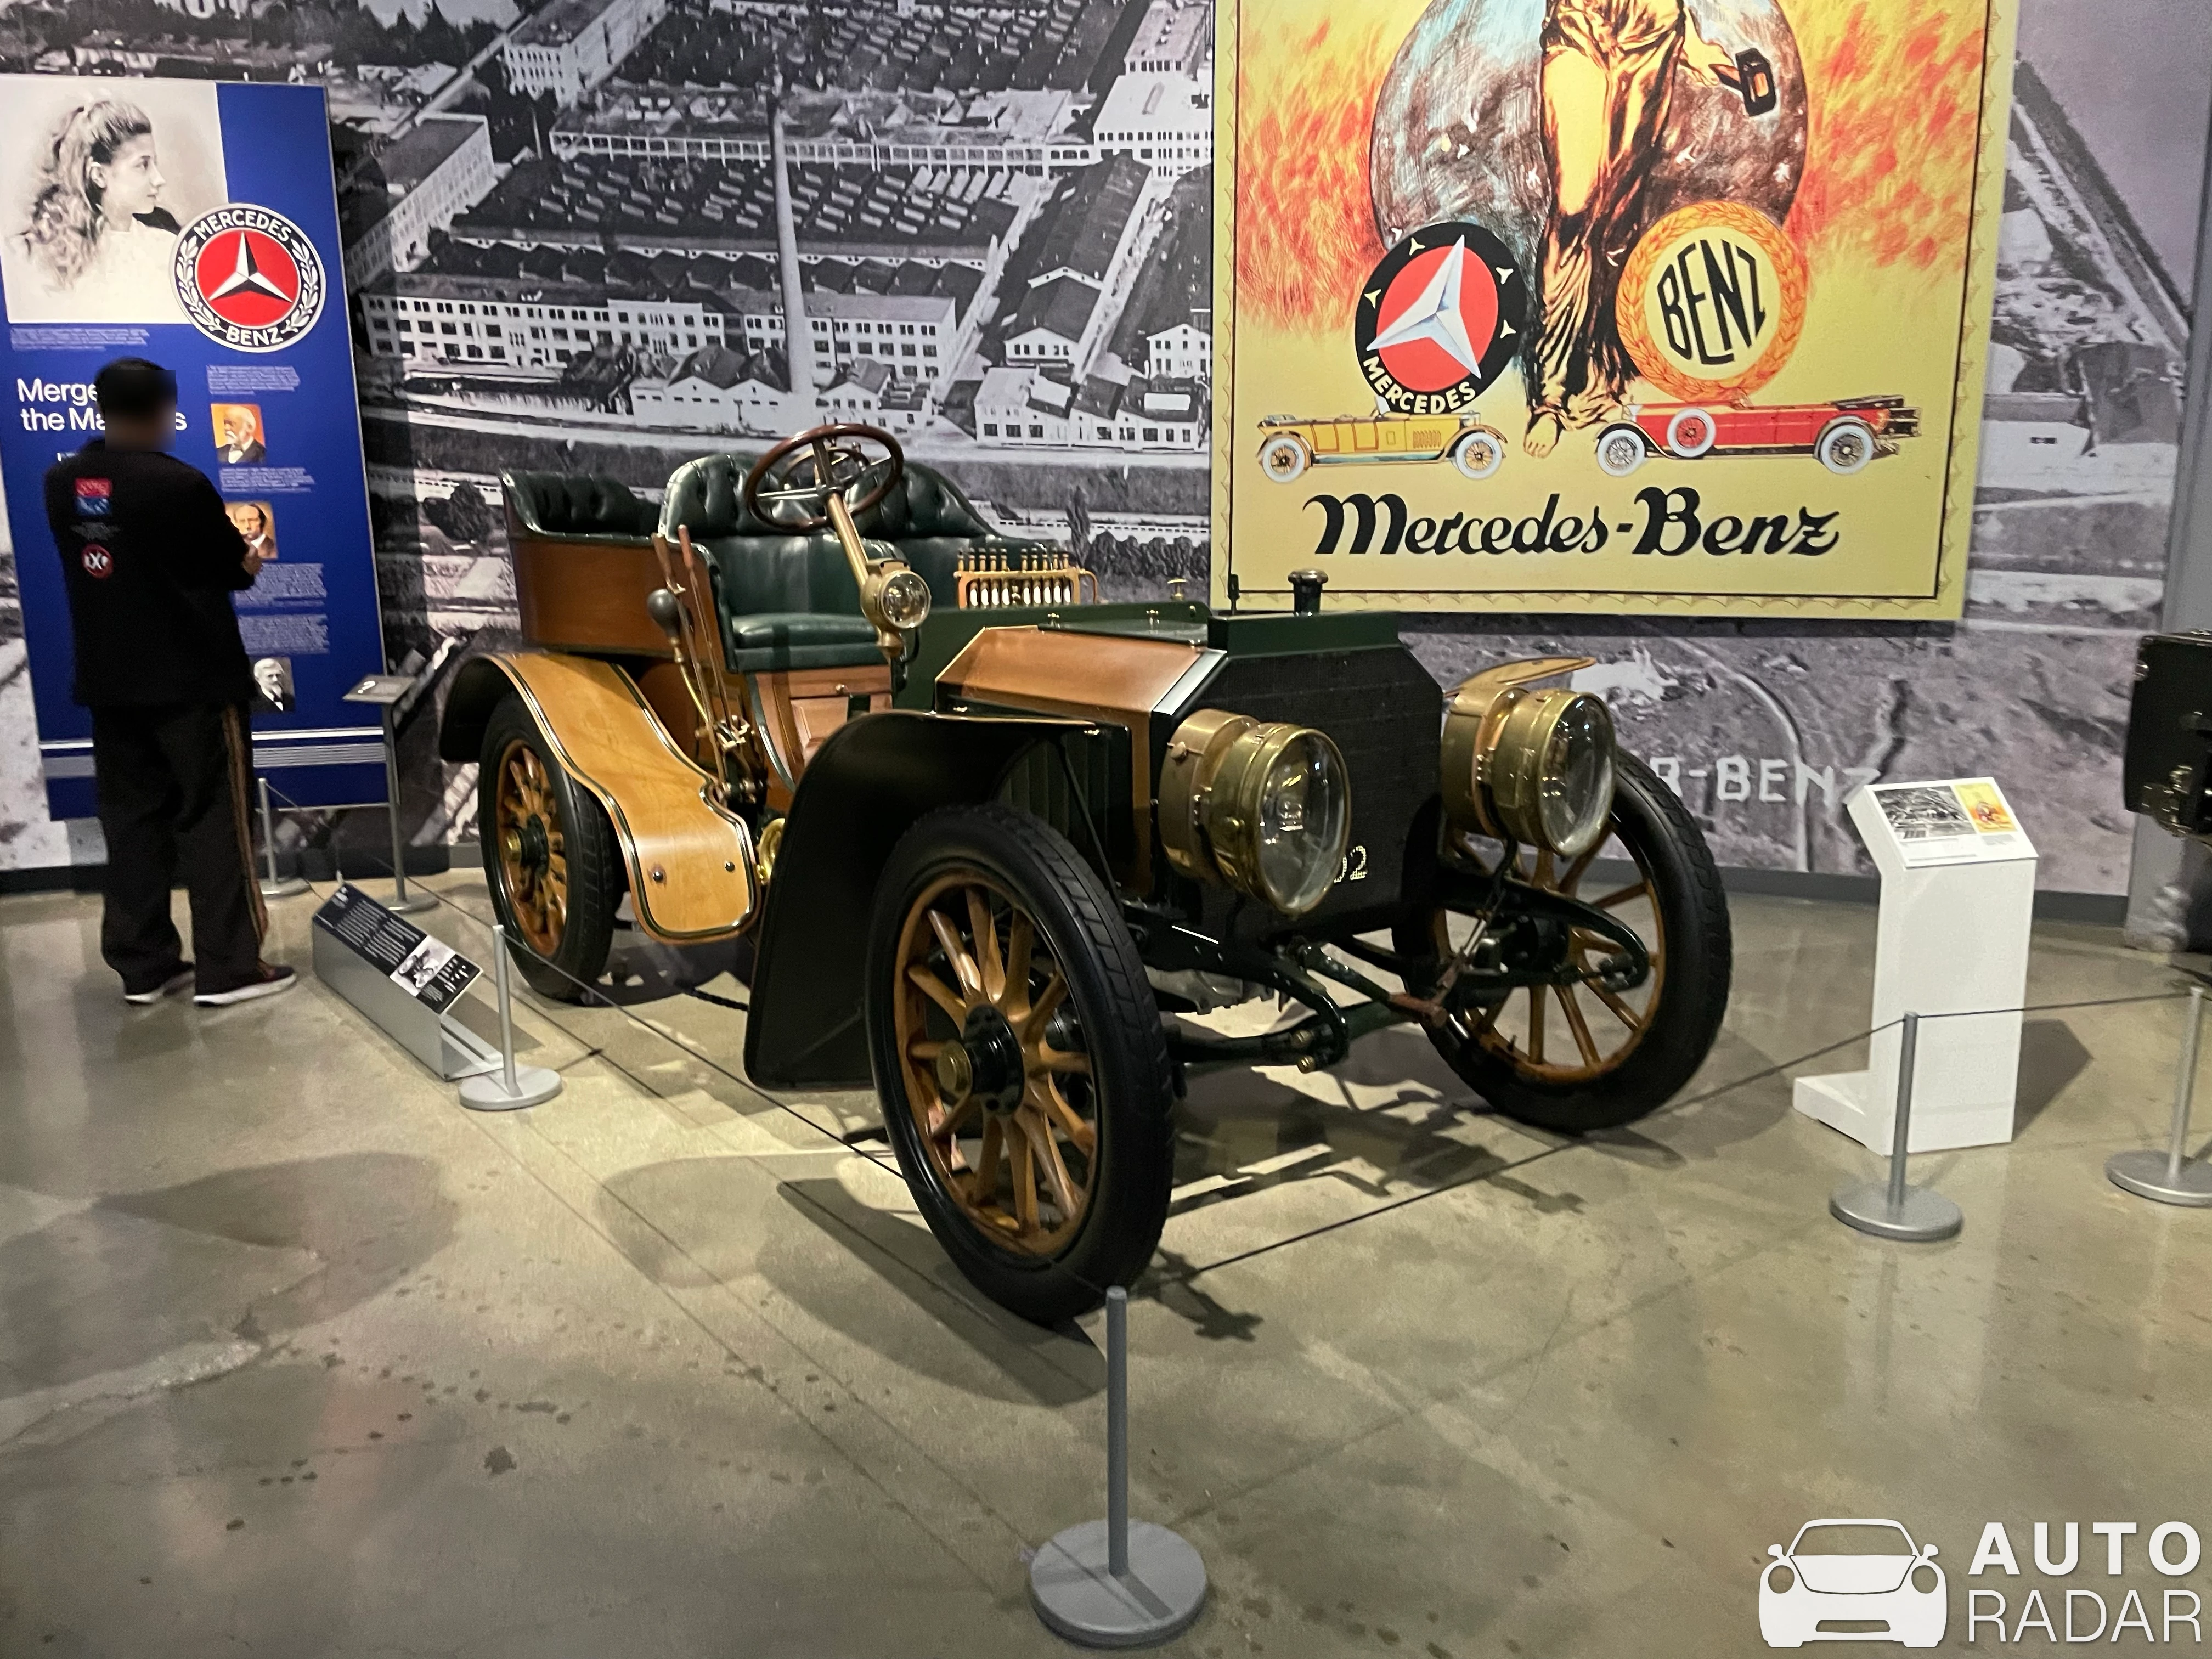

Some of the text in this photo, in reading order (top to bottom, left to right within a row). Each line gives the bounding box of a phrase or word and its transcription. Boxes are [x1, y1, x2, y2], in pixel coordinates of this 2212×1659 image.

[194, 210, 291, 241] MERCEDES
[1657, 239, 1766, 364] BENZ
[225, 328, 284, 346] BENZ
[1363, 356, 1476, 414] MERCEDES
[20, 407, 65, 431] the
[1302, 486, 1840, 556] Mercedes-Benz
